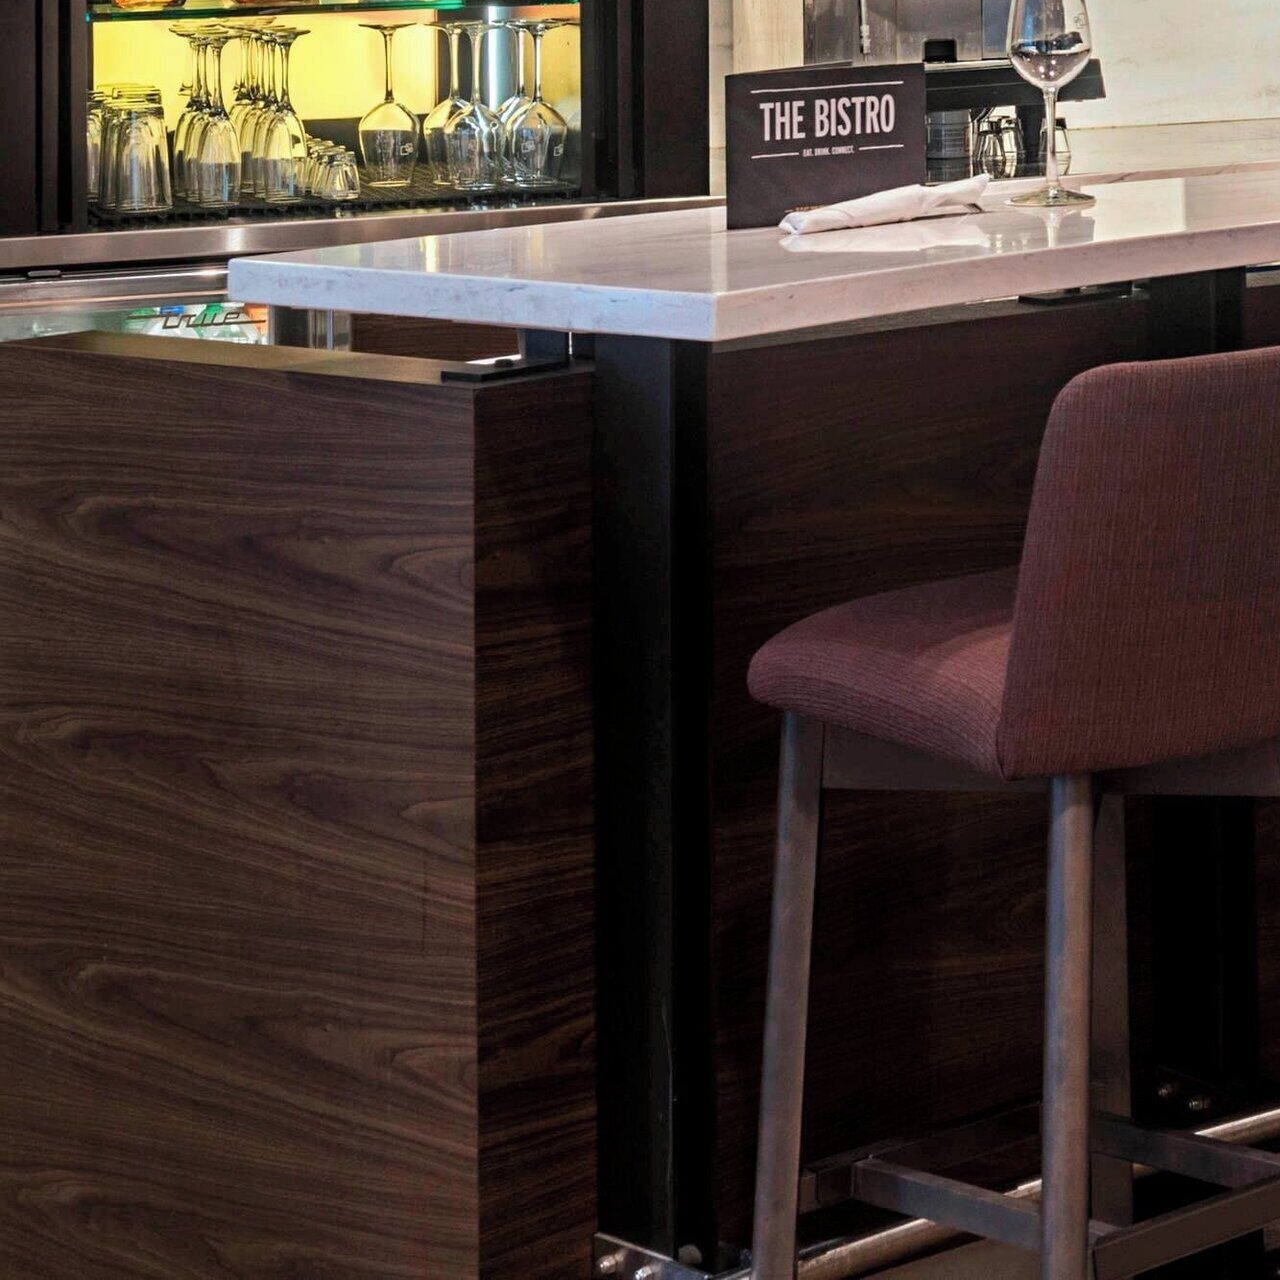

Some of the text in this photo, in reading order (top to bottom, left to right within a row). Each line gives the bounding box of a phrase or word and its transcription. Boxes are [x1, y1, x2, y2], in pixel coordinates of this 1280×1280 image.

[760, 94, 895, 141] THE BISTRO
[803, 146, 854, 157] EAT. DRINK. CONNECT.
